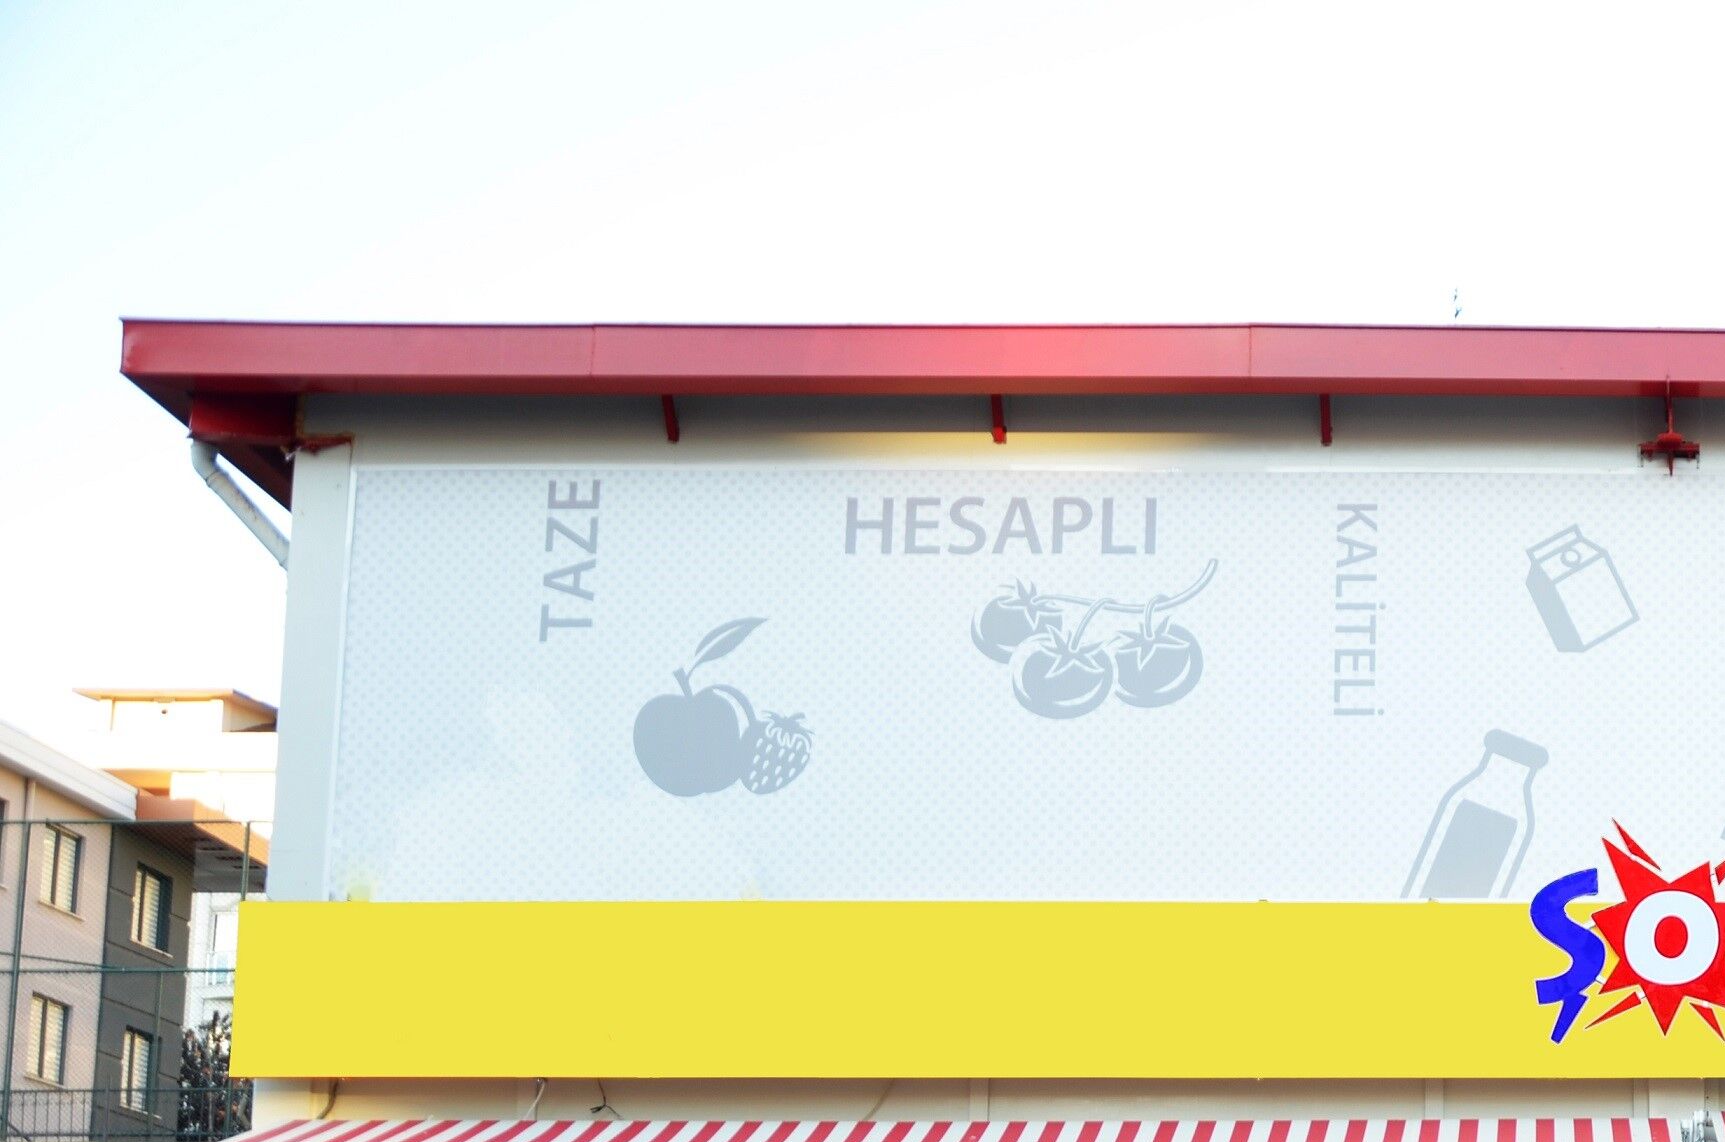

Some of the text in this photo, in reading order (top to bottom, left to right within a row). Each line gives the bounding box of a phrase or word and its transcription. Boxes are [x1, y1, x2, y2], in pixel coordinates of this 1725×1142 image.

[539, 479, 601, 643] TAZE
[844, 496, 1159, 556] HESAPLI
[1333, 502, 1385, 717] KALİTELİ
